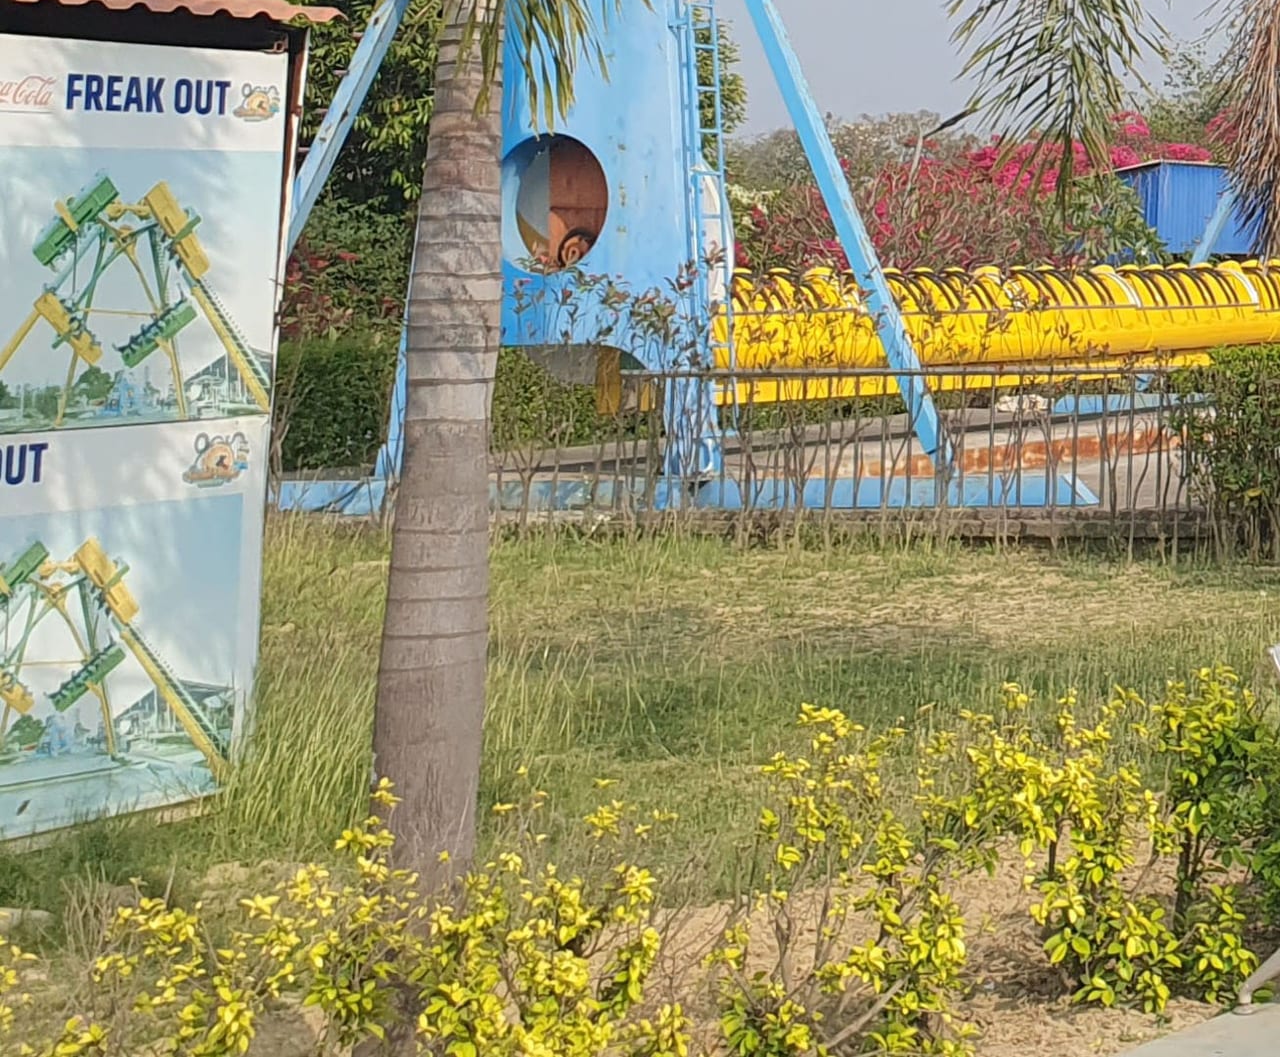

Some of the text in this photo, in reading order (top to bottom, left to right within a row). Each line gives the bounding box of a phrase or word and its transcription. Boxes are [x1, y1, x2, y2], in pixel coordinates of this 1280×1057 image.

[0, 75, 57, 106] a-Cola
[66, 73, 231, 115] FREAK OUT
[0, 442, 49, 485] UT
